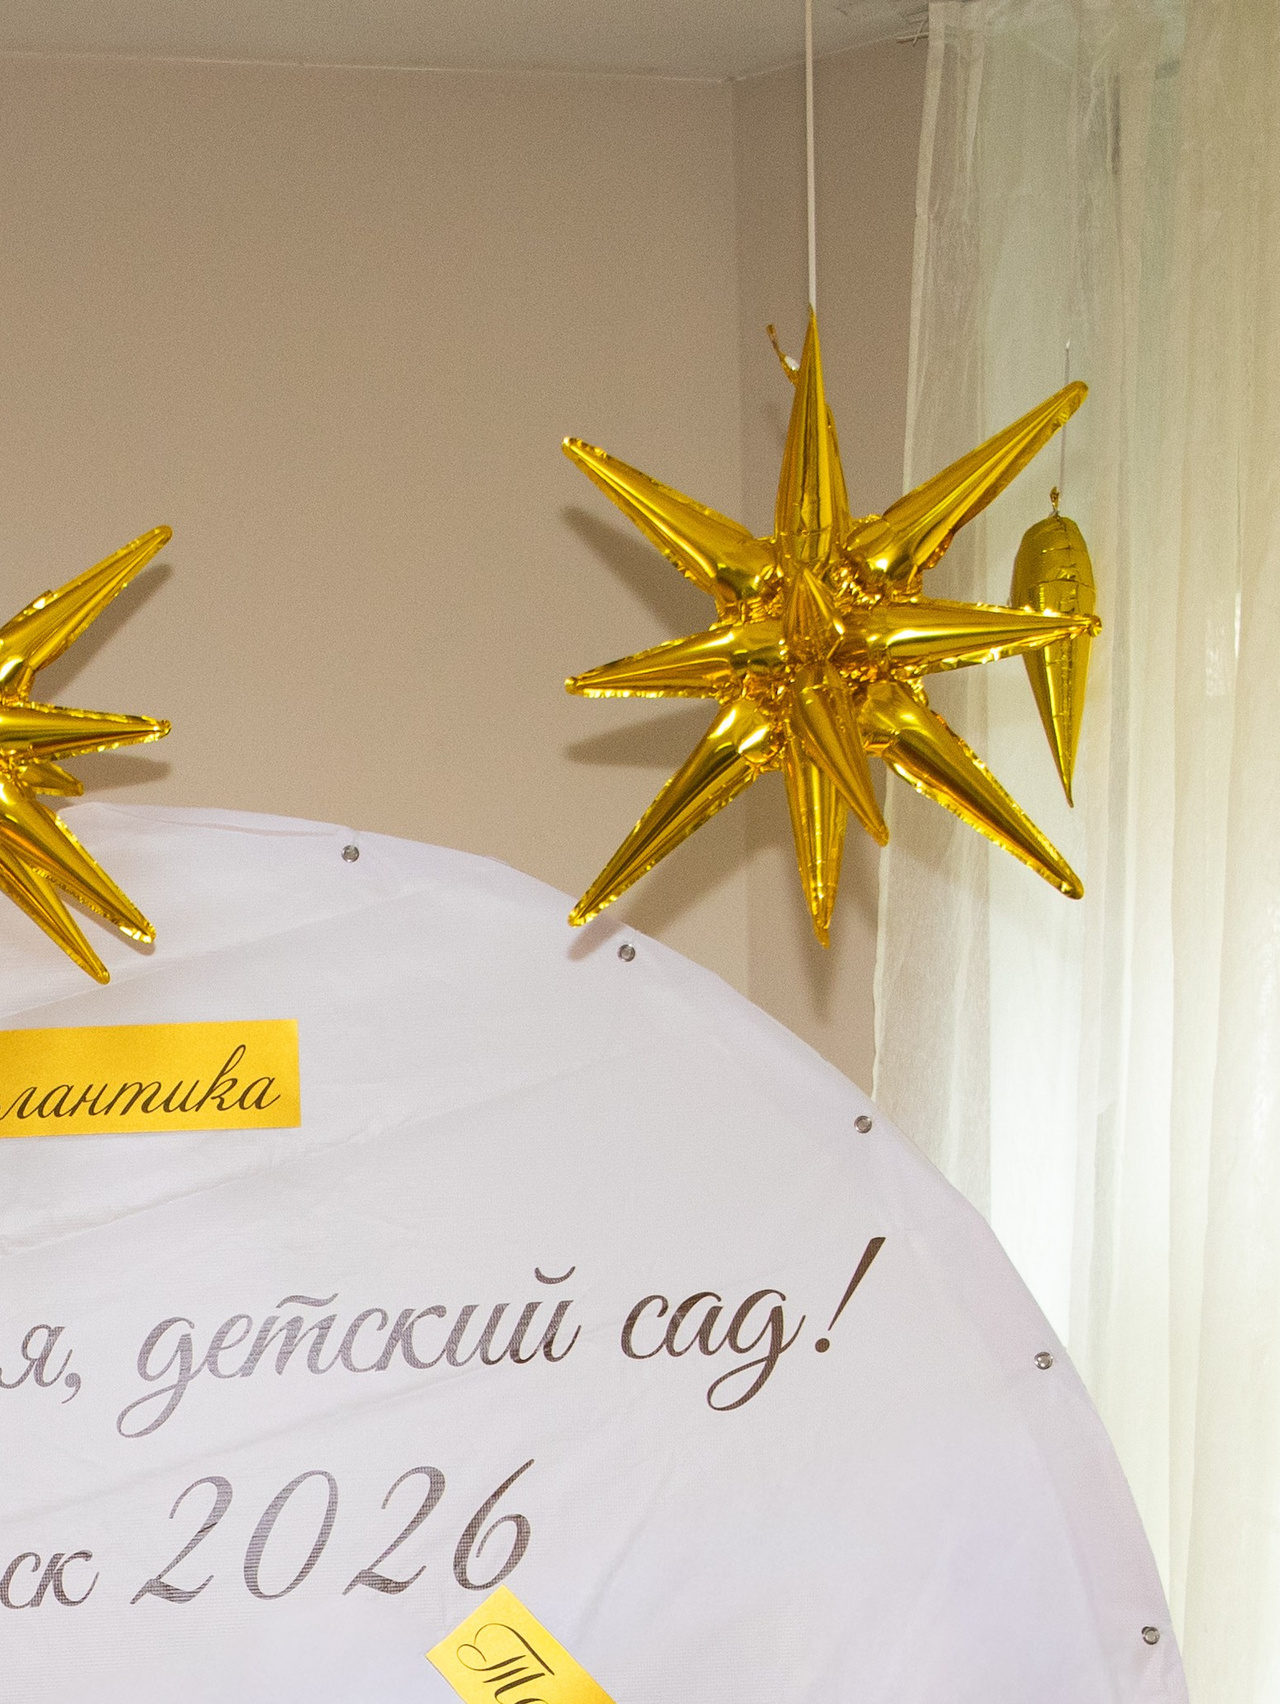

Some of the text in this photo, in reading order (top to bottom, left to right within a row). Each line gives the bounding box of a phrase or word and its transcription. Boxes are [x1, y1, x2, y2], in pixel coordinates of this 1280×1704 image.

[116, 1265, 581, 1438] детский
[620, 1235, 886, 1410] сад!
[131, 1458, 533, 1605] 2026
